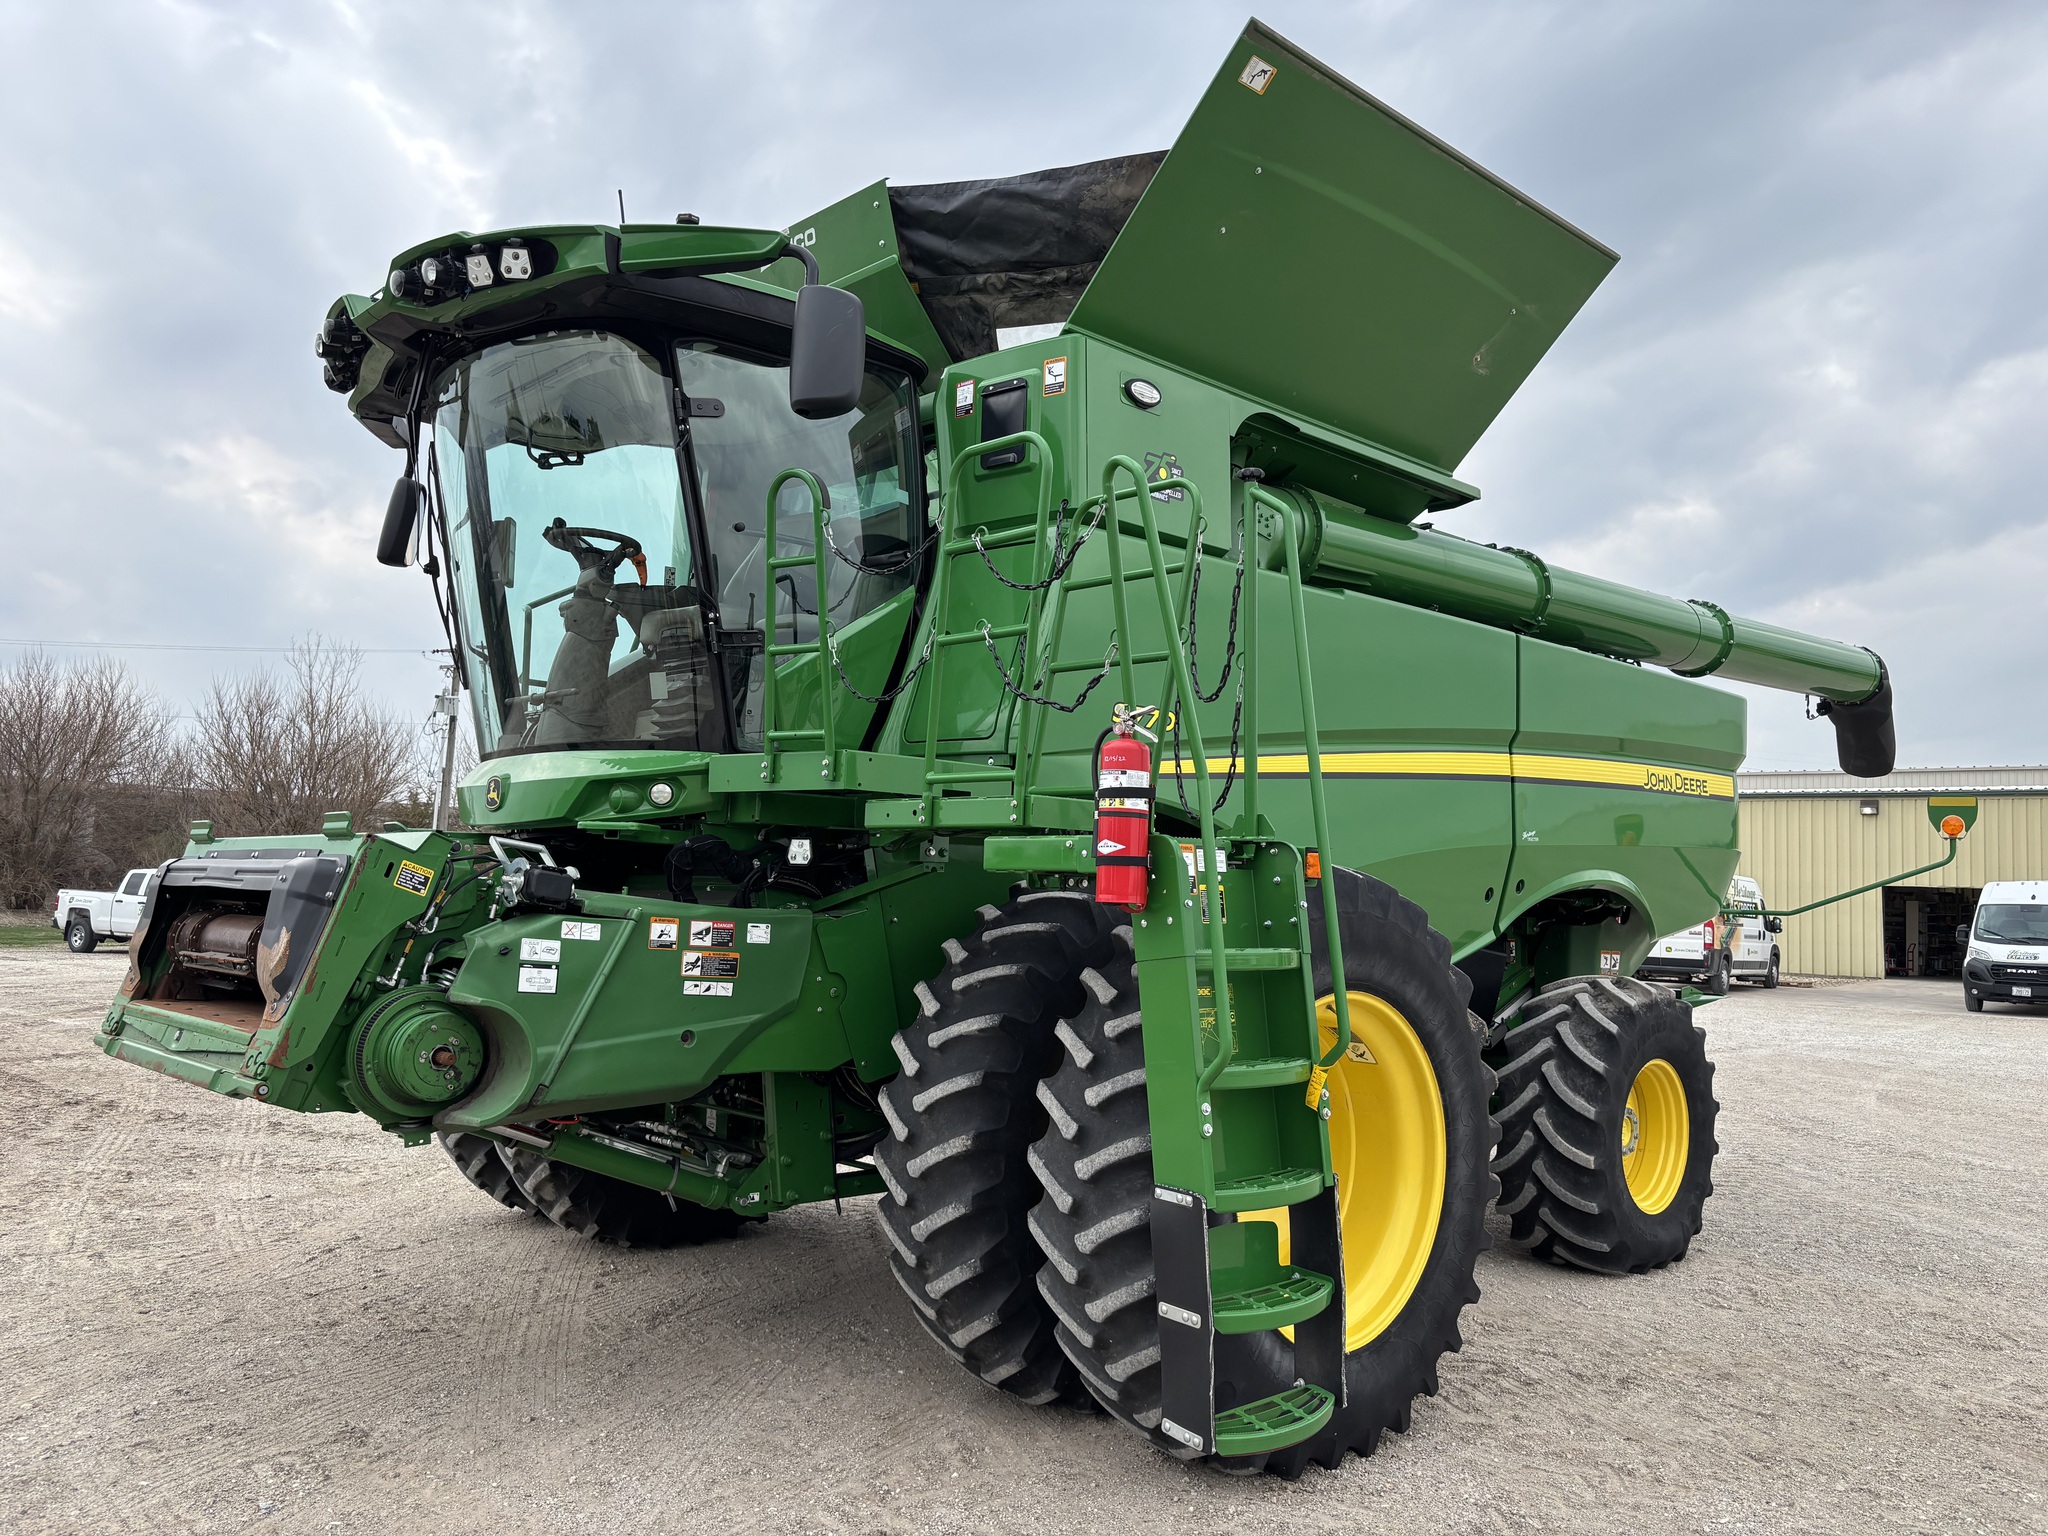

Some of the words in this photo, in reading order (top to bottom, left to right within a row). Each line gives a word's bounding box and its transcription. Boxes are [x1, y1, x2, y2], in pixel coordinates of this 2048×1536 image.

[1643, 769, 1673, 789] JOHN
[1674, 772, 1709, 794] DEERE
[407, 863, 433, 876] CAUTION
